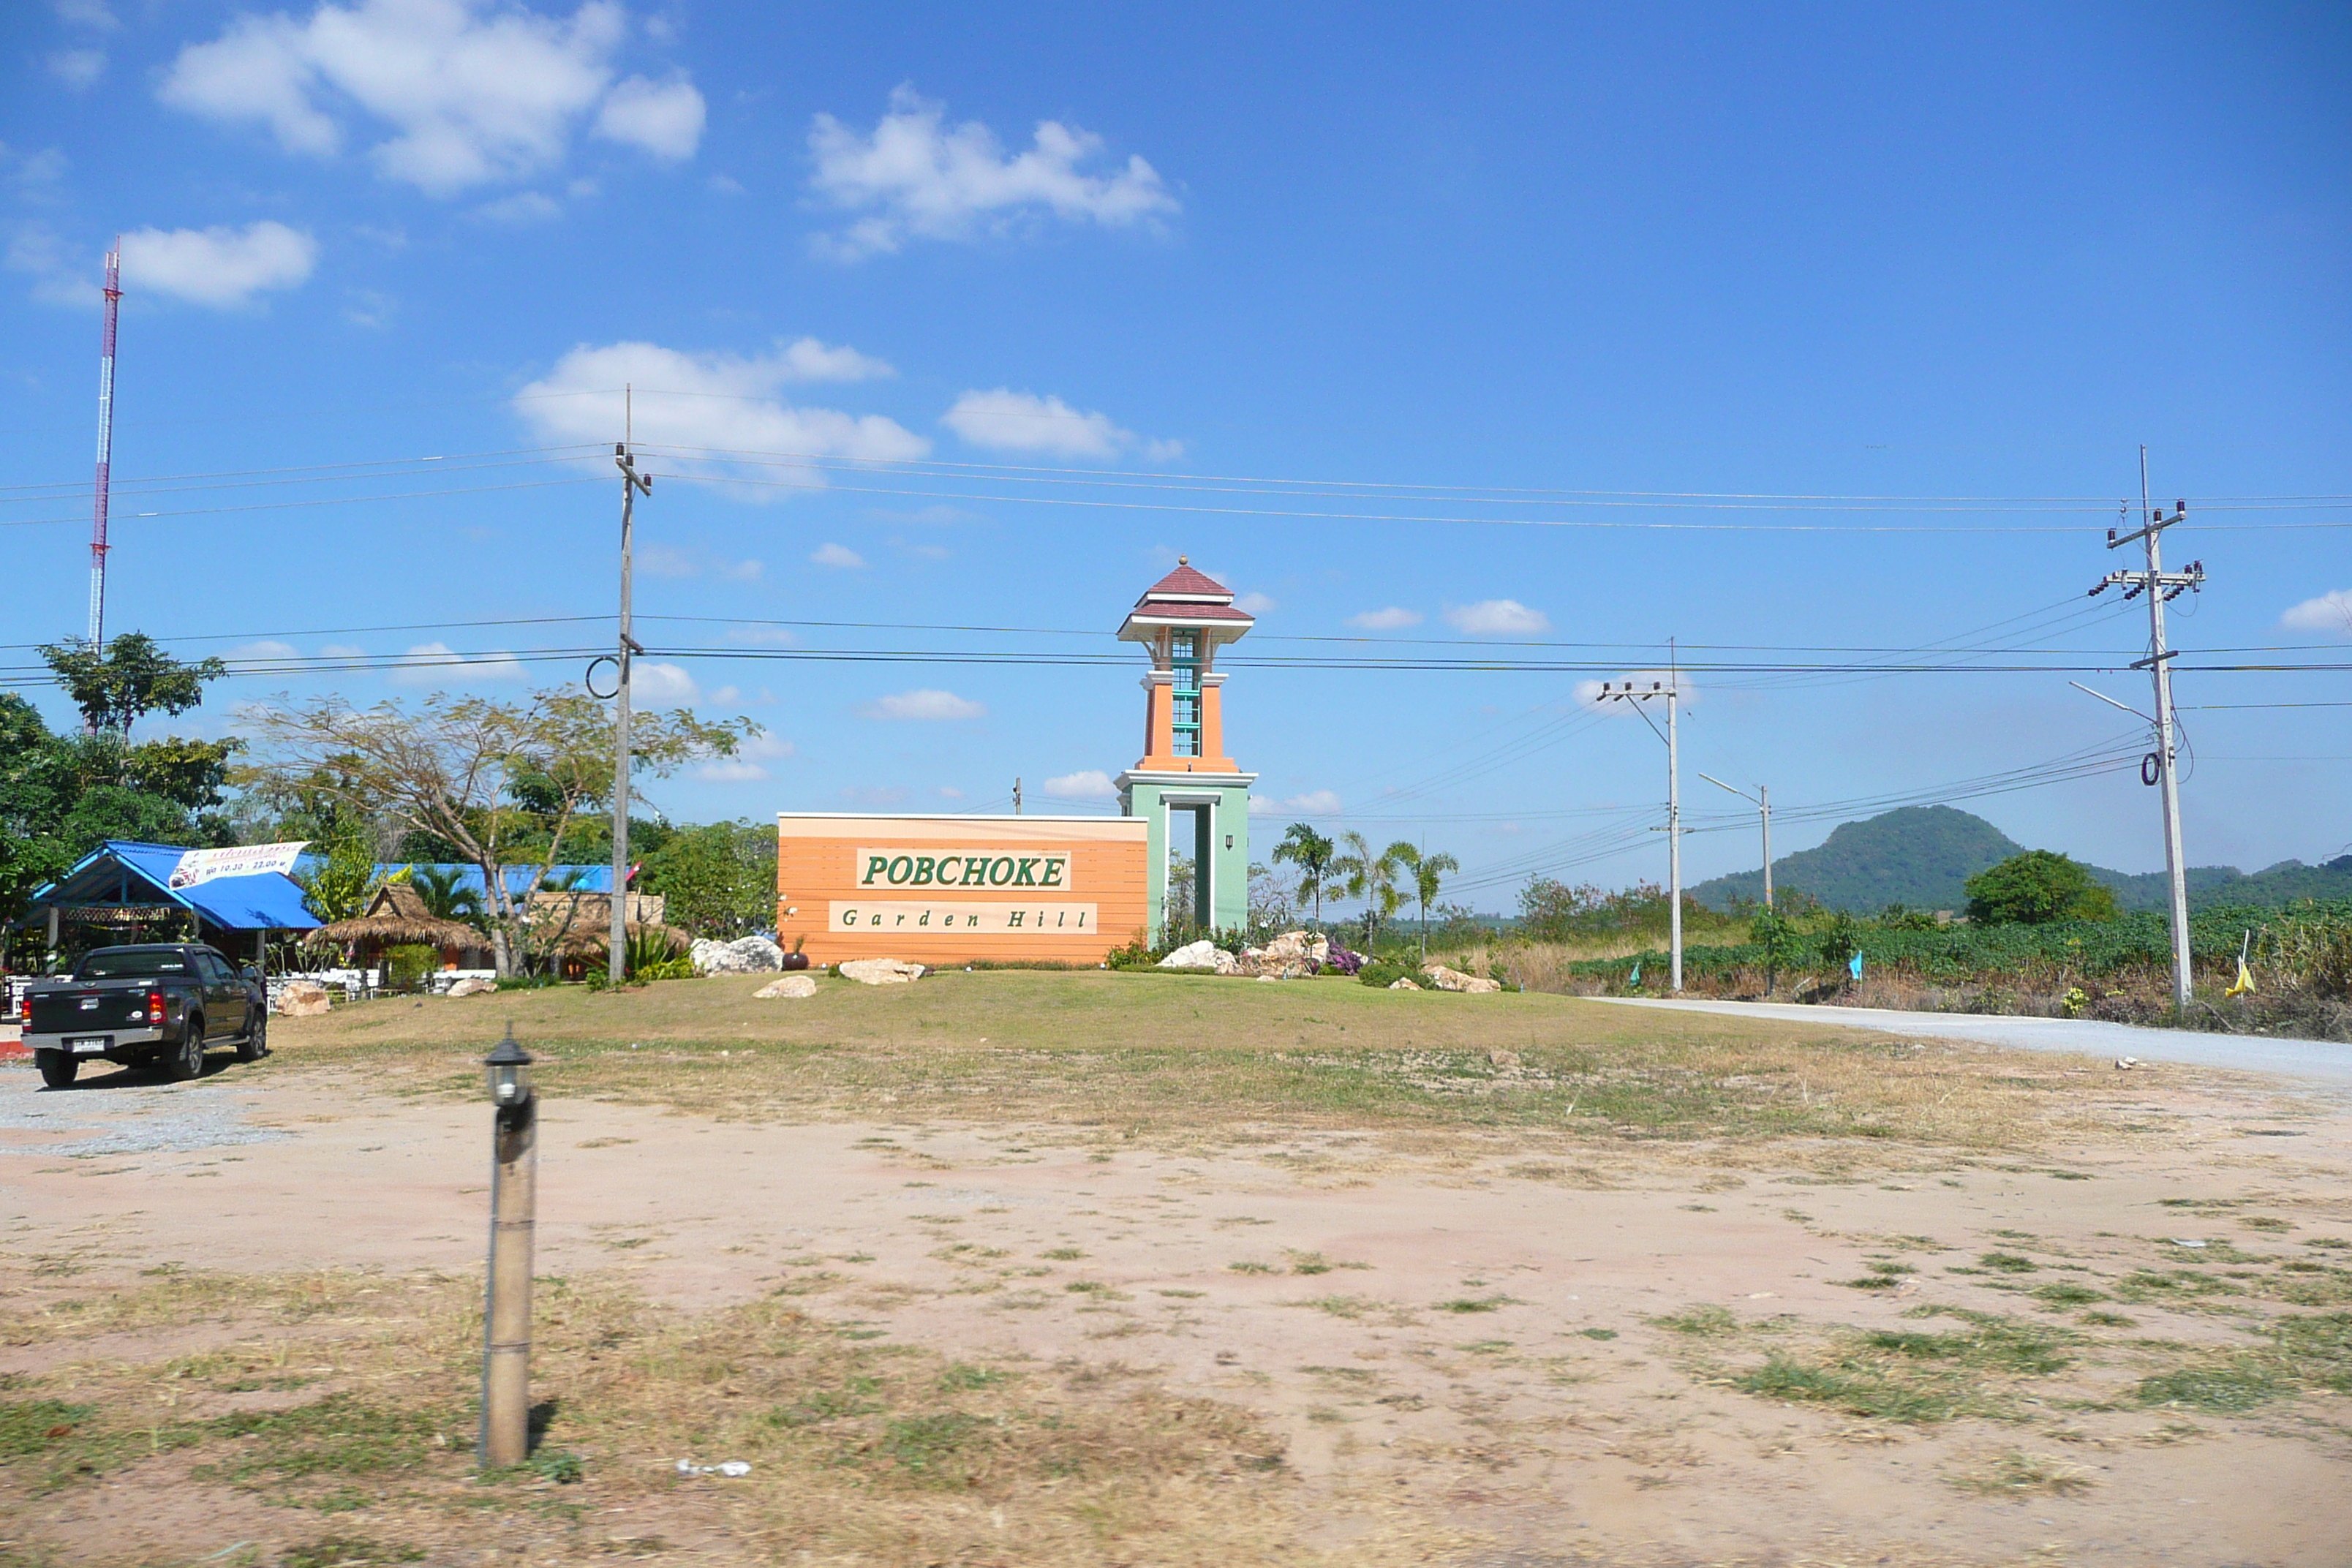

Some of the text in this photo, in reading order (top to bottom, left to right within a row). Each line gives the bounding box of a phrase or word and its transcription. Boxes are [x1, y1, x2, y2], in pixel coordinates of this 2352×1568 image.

[252, 860, 276, 869] 22.00
[862, 856, 1065, 886] POBCHOKE
[843, 910, 1085, 927] Garden Hill
